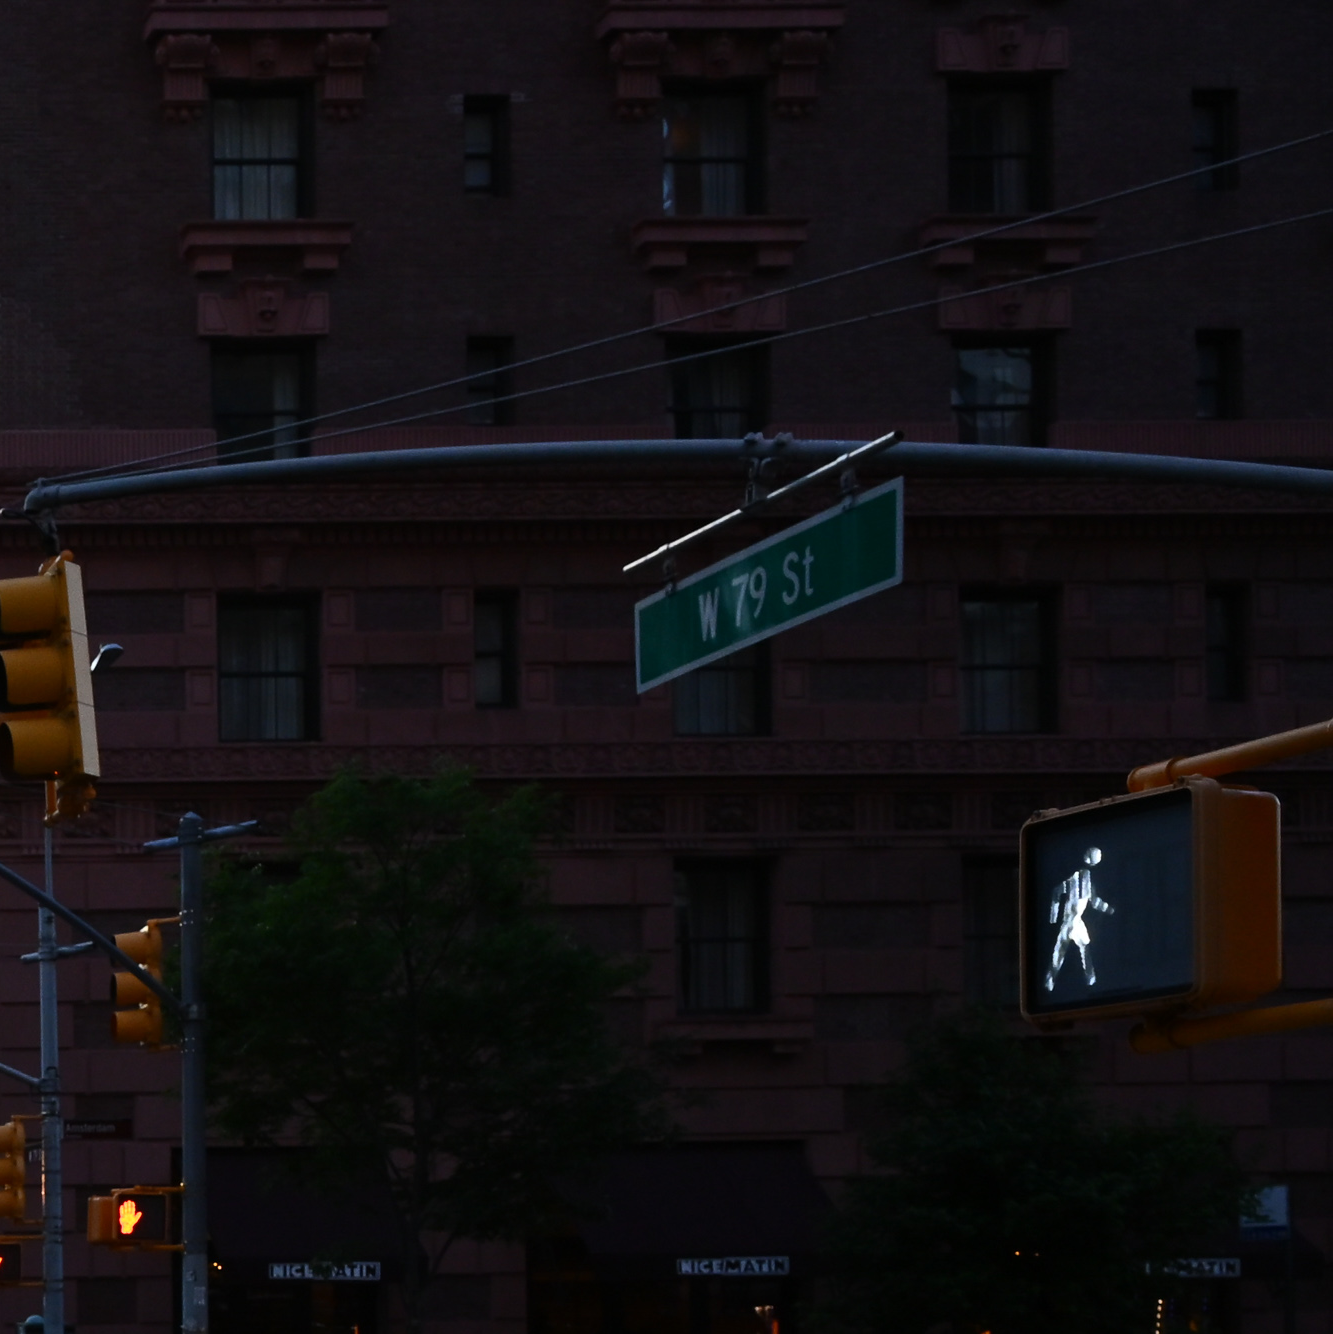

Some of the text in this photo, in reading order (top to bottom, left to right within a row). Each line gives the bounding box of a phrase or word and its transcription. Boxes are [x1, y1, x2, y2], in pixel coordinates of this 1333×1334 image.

[698, 545, 815, 643] W 79 St
